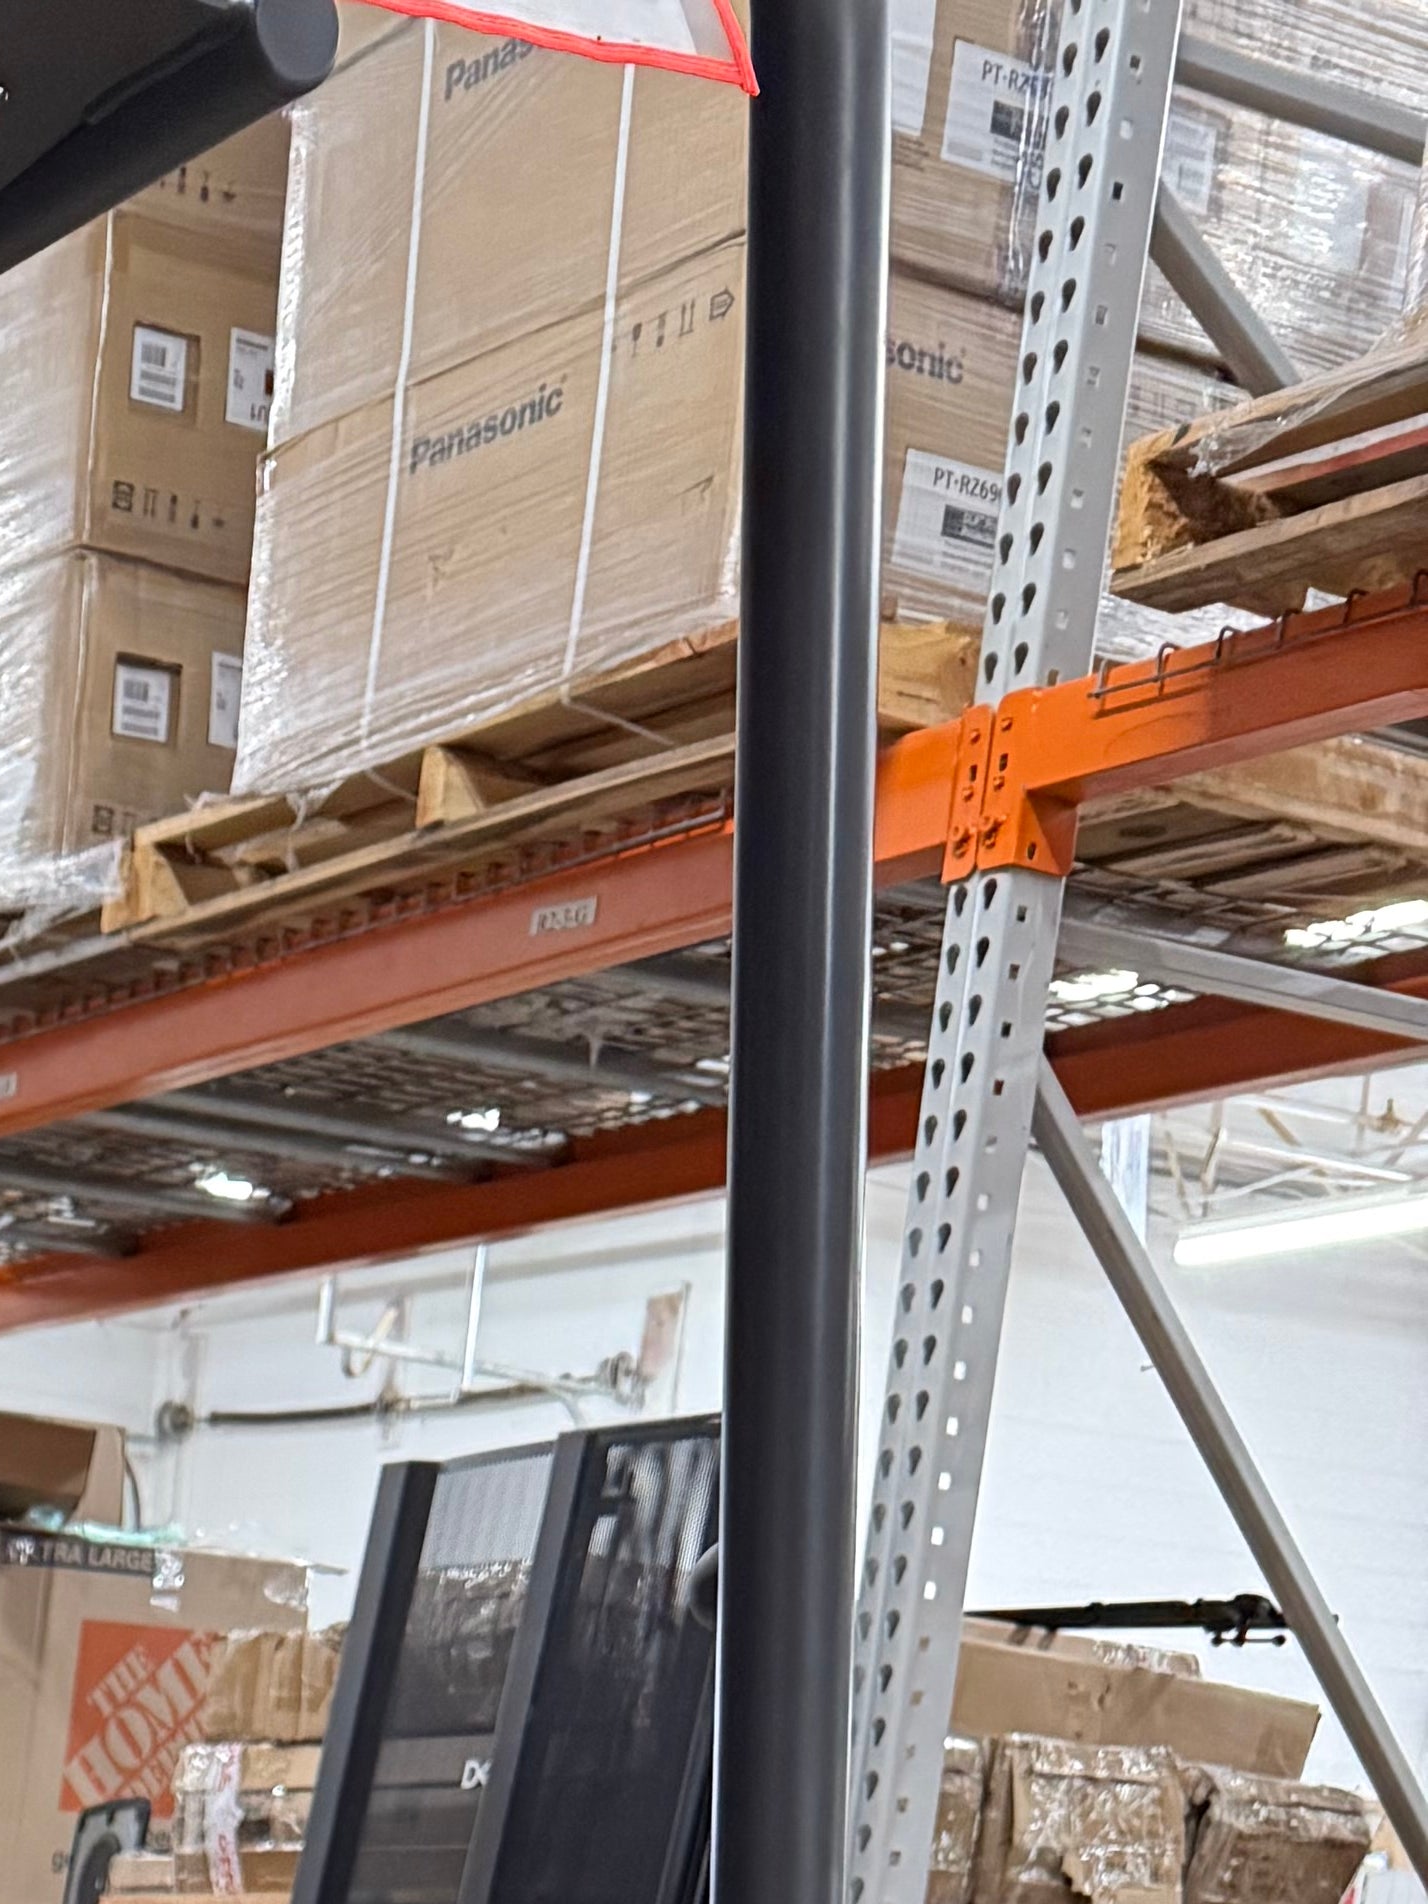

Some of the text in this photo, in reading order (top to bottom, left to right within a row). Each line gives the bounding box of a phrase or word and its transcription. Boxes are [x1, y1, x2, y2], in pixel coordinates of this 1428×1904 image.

[409, 382, 564, 475] Panasonic
[933, 467, 1003, 502] PT-RZ69
[87, 1547, 152, 1572] LARGE
[87, 1644, 149, 1718] THE
